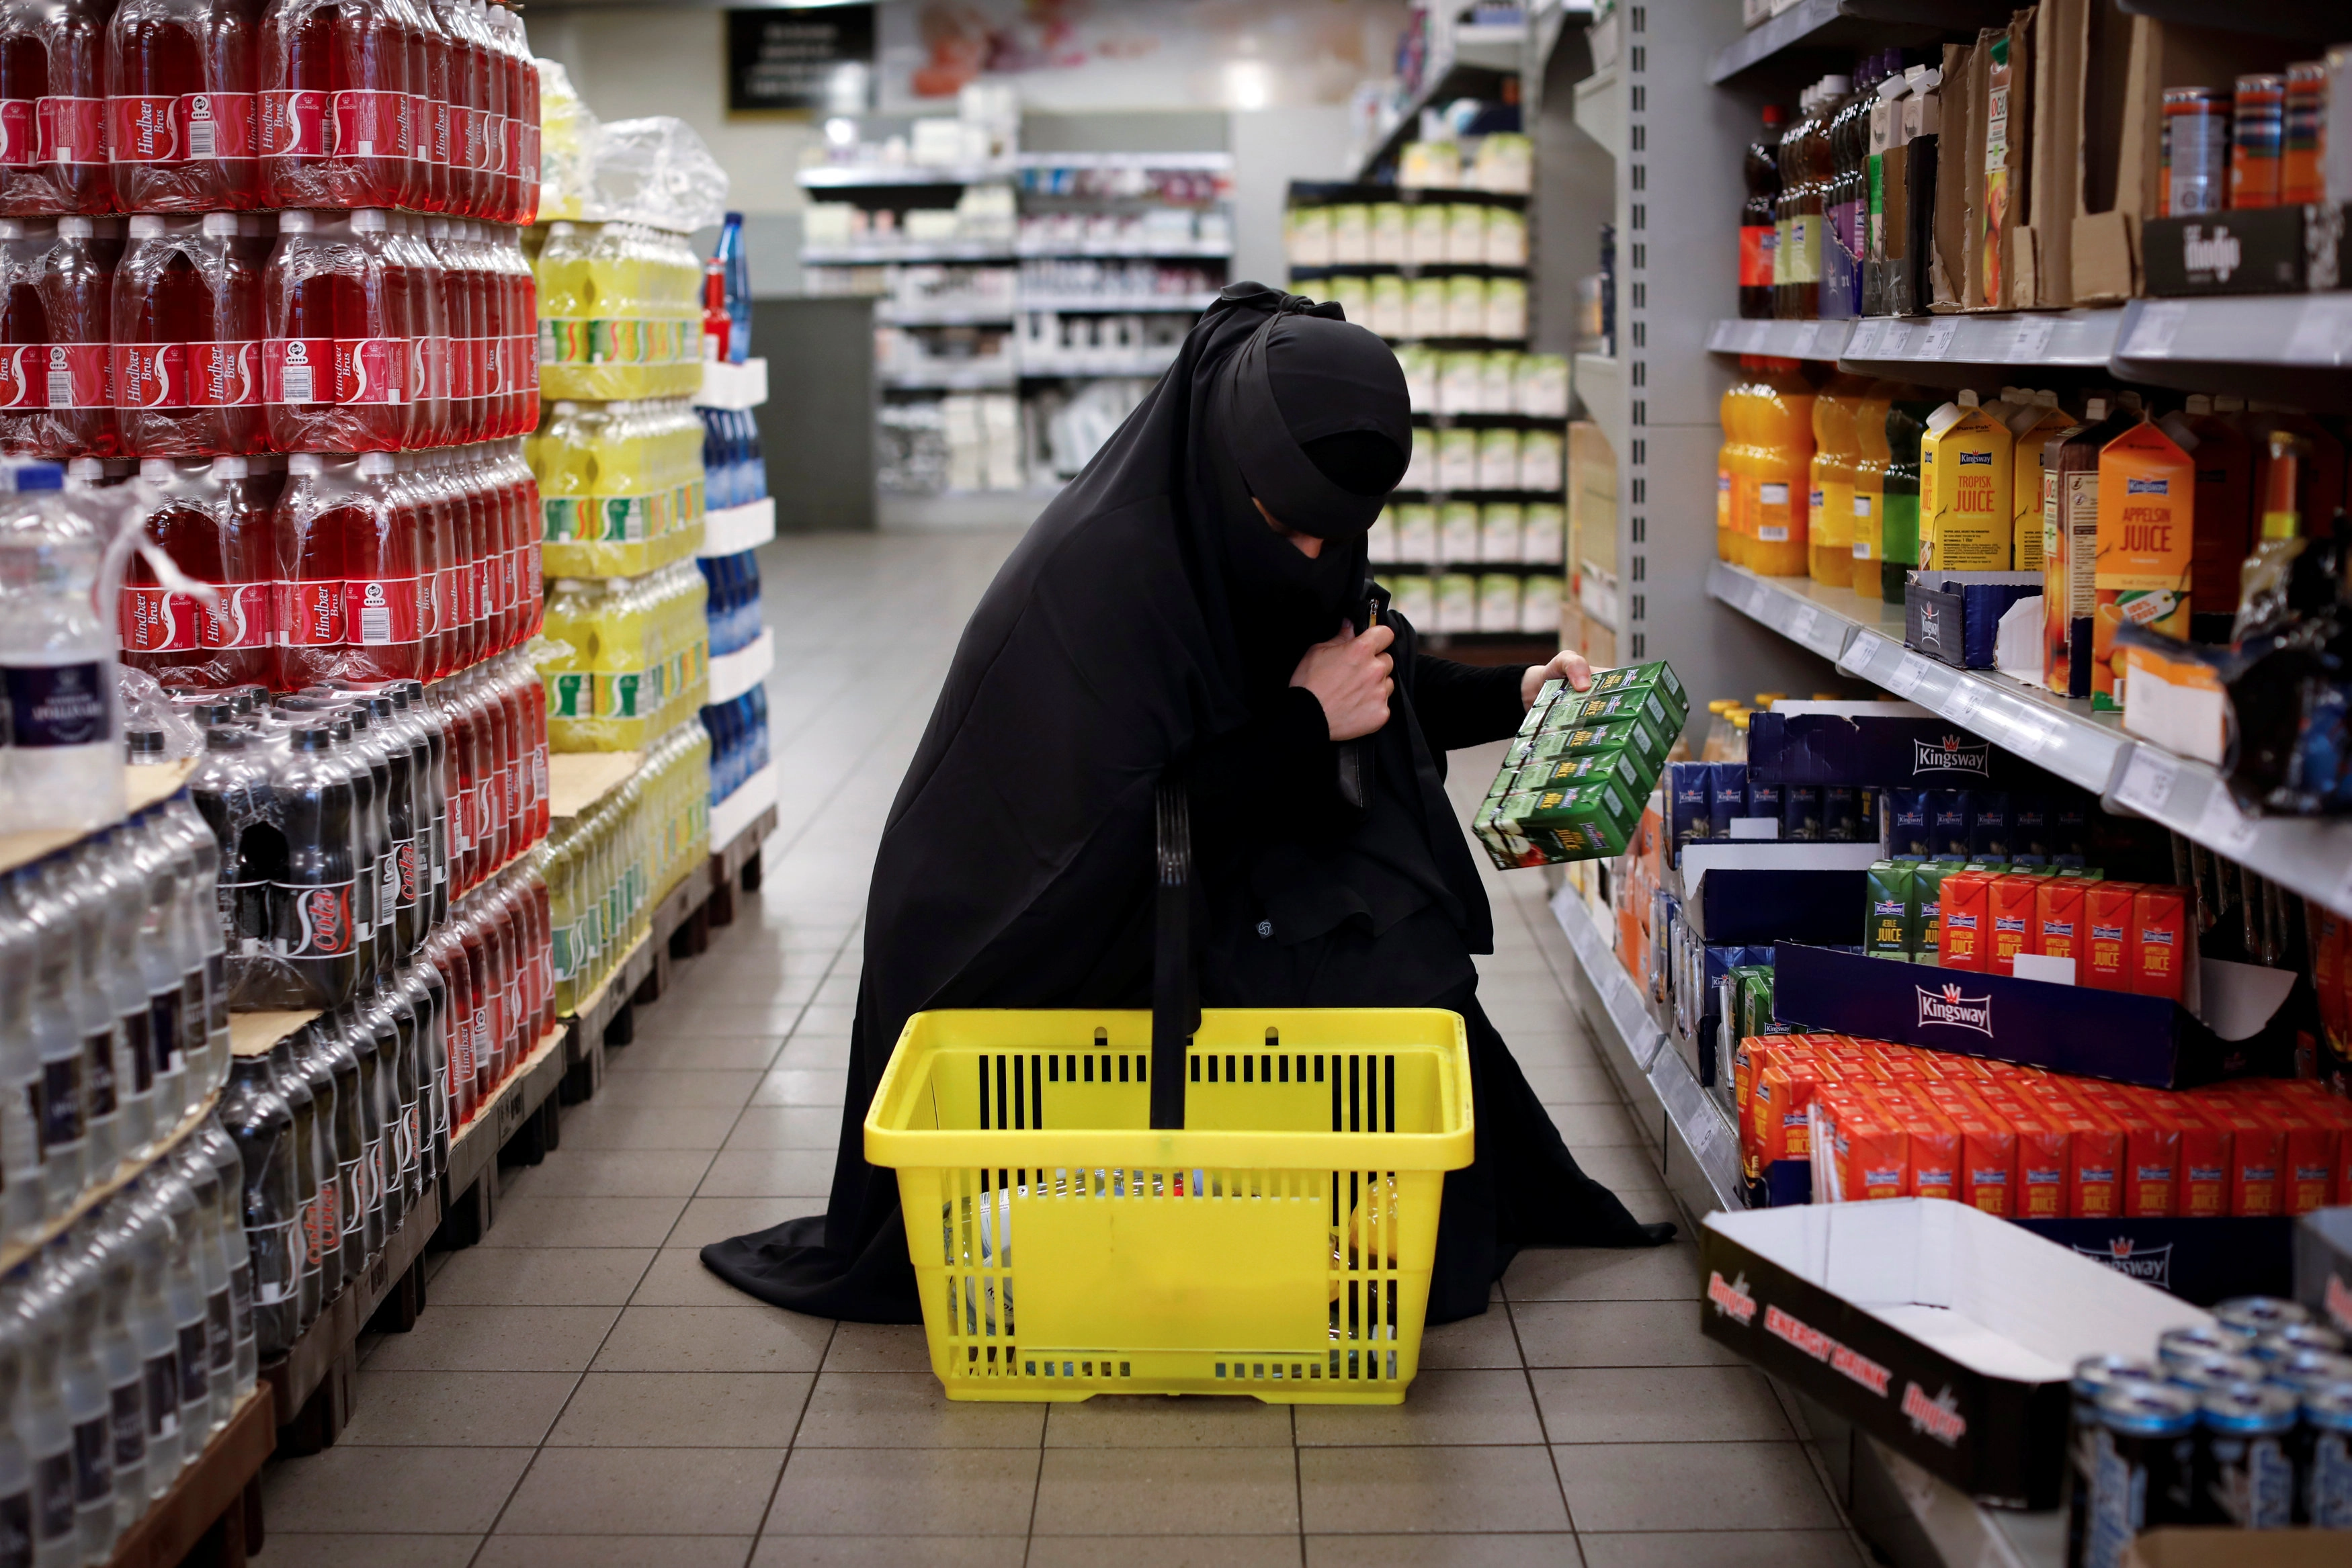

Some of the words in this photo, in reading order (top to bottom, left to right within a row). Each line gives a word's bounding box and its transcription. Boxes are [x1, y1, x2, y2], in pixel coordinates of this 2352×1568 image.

[154, 109, 165, 134] Brus
[262, 95, 274, 150] Hindbær
[274, 103, 284, 128] Brus
[136, 100, 153, 155] Hindbær
[435, 105, 447, 157] Hindbær
[0, 357, 9, 382] Brus
[126, 349, 141, 402] Hindbær
[141, 357, 152, 382] Brus
[207, 347, 224, 401] Hindbær
[224, 354, 236, 380] Brus
[342, 352, 351, 377] Brus
[1961, 453, 1991, 464] Kingsway
[1958, 475, 1992, 488] TROPISK
[1953, 490, 1996, 513] JUICE
[2122, 507, 2172, 523] APPELSIN
[2119, 525, 2173, 553] JUICE
[148, 601, 159, 625] Brus
[312, 586, 331, 639] Hindbær
[330, 594, 339, 617] Brus
[134, 593, 148, 646] Hindbær
[206, 606, 220, 644] Hindb
[1584, 701, 1601, 716] JUICE
[1919, 747, 1984, 770] Kingsway
[1900, 816, 1923, 825] Kingsway
[1554, 828, 1581, 851] JUICE
[399, 842, 415, 900] Cola
[308, 888, 338, 951] Cola
[1876, 905, 1902, 914] Kingsway
[1923, 906, 1940, 914] Kings
[1882, 919, 1898, 928] ÆBLE
[1949, 918, 1974, 927] Kingsway
[1876, 928, 1903, 942] JUICE
[1923, 929, 1940, 943] JUI
[1949, 939, 1974, 954] JUICE
[1997, 943, 2023, 957] JUICE
[2093, 951, 2119, 967] JUICE
[2143, 955, 2171, 971] JUICE
[1923, 996, 1987, 1027] Kingsway
[1766, 1025, 1790, 1033] Kingsway
[1763, 1303, 1834, 1364] ENERGY
[1829, 1342, 1894, 1399] DRINK
